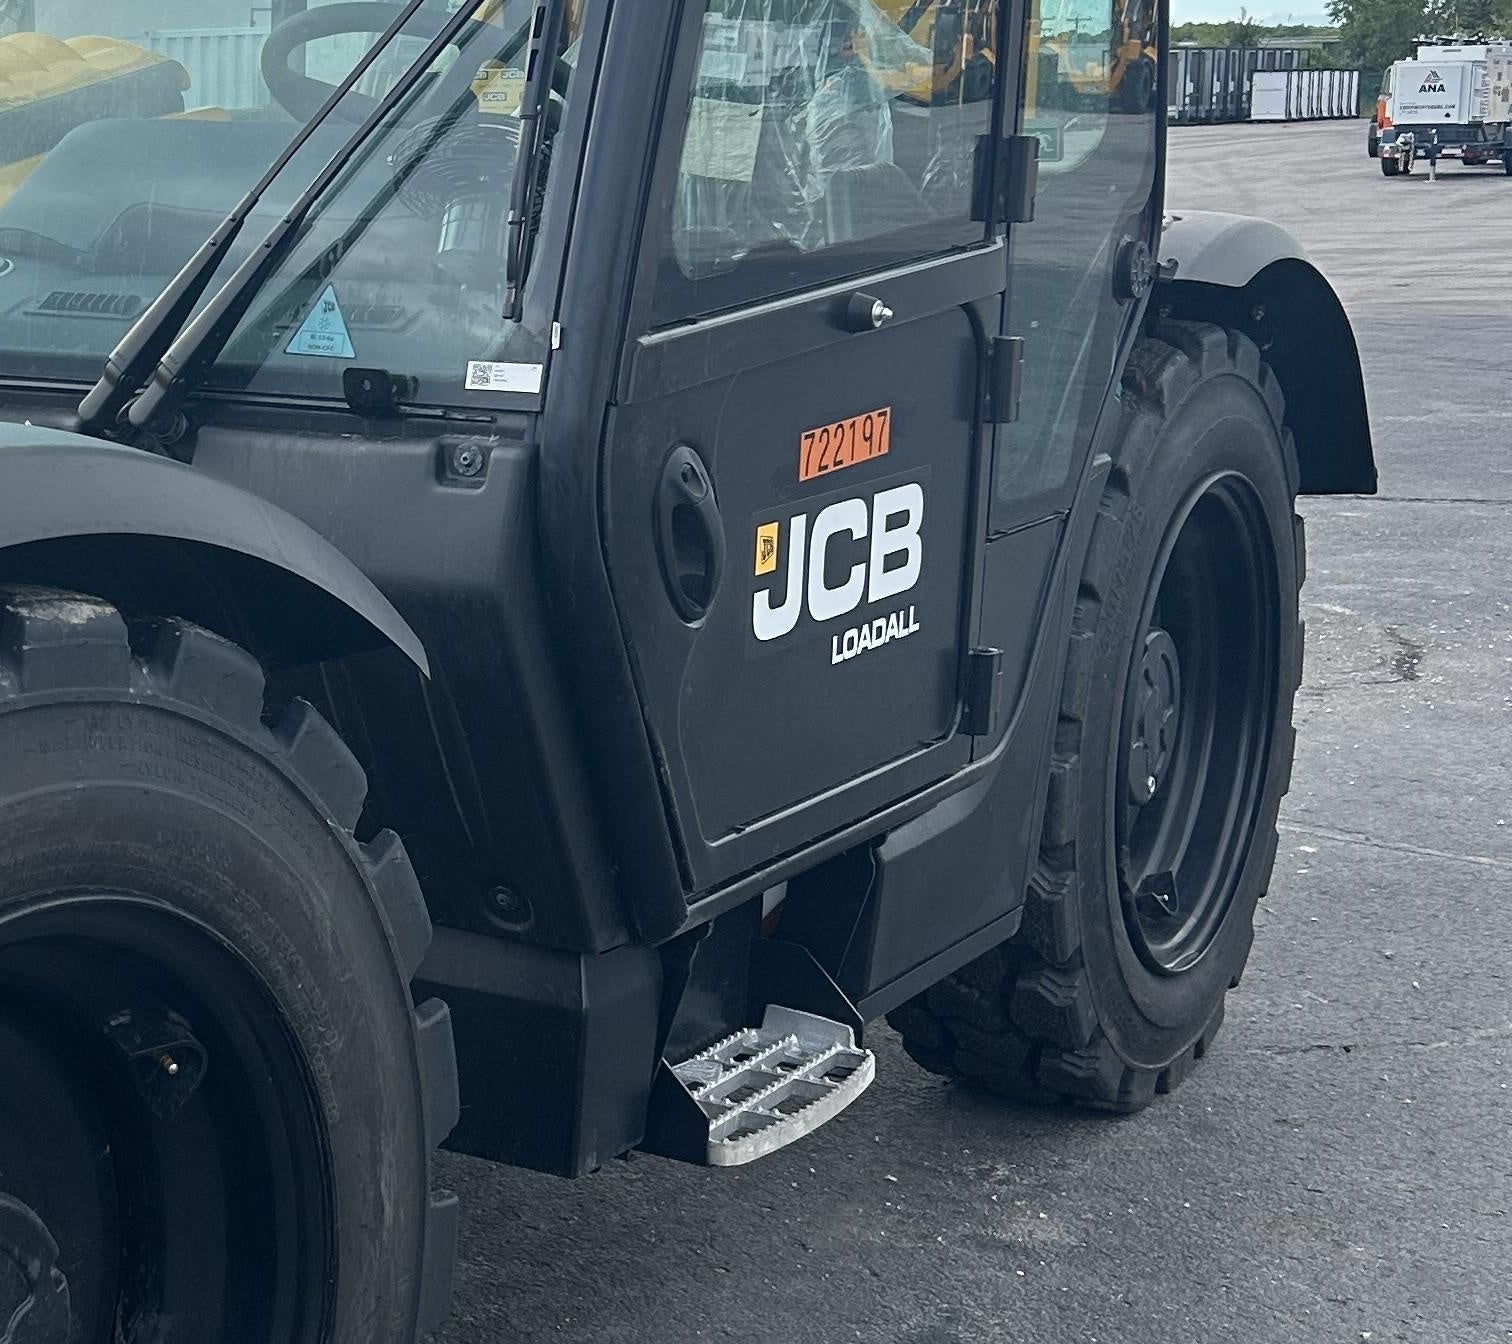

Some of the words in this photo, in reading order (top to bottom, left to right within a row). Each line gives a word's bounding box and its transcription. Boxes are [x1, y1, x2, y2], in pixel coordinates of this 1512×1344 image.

[483, 93, 506, 101] JCB
[1418, 84, 1446, 93] ANA
[803, 410, 888, 477] 722197
[753, 482, 924, 641] JCB
[831, 605, 920, 665] LOADALL
